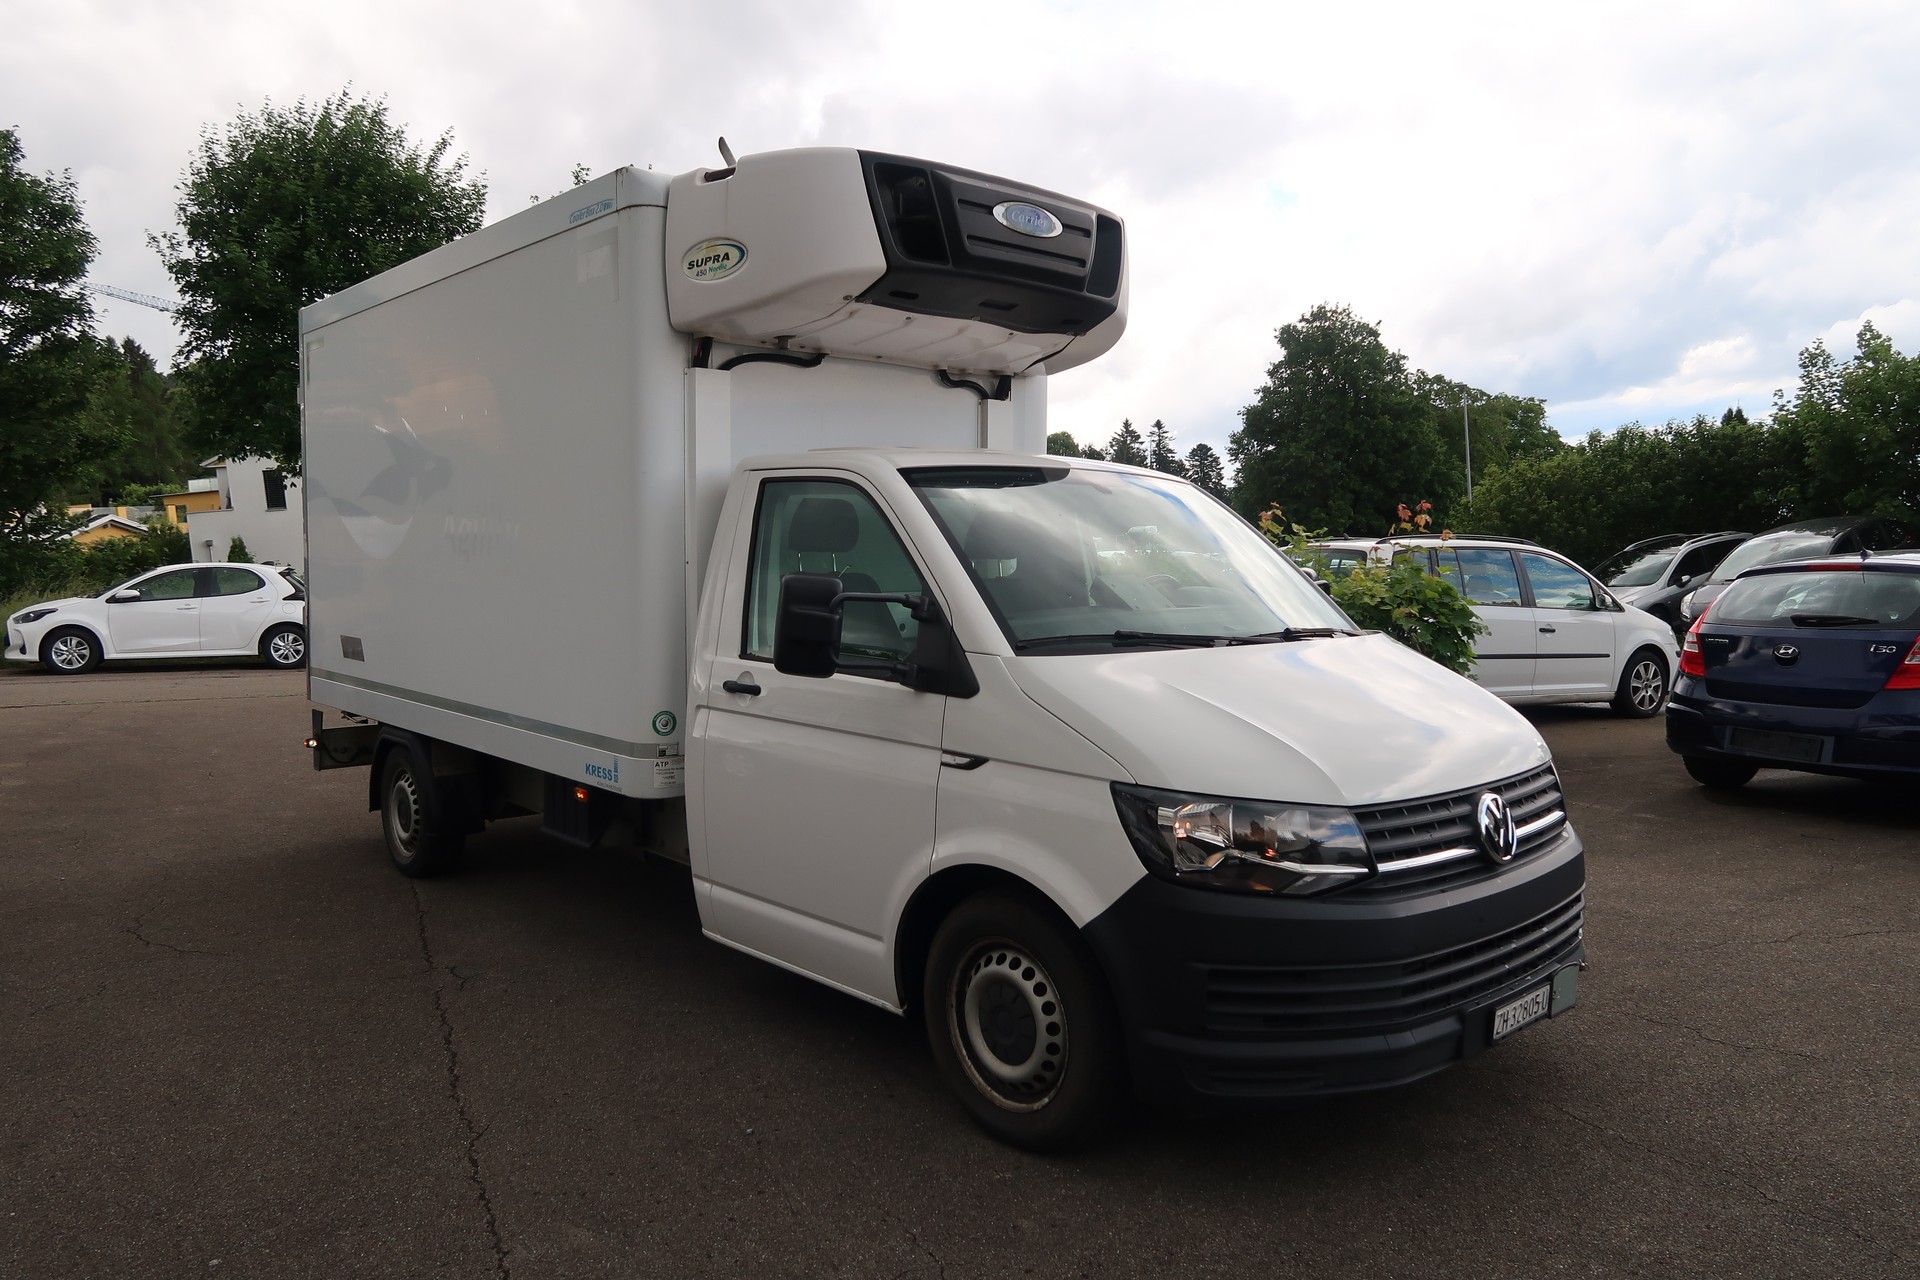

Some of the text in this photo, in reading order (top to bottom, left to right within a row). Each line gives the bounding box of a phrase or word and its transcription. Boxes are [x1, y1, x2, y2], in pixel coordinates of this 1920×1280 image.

[1011, 210, 1047, 228] Carrier
[687, 252, 730, 270] SUPRA
[695, 263, 728, 277] 450 Nordic
[585, 762, 613, 781] KRESS
